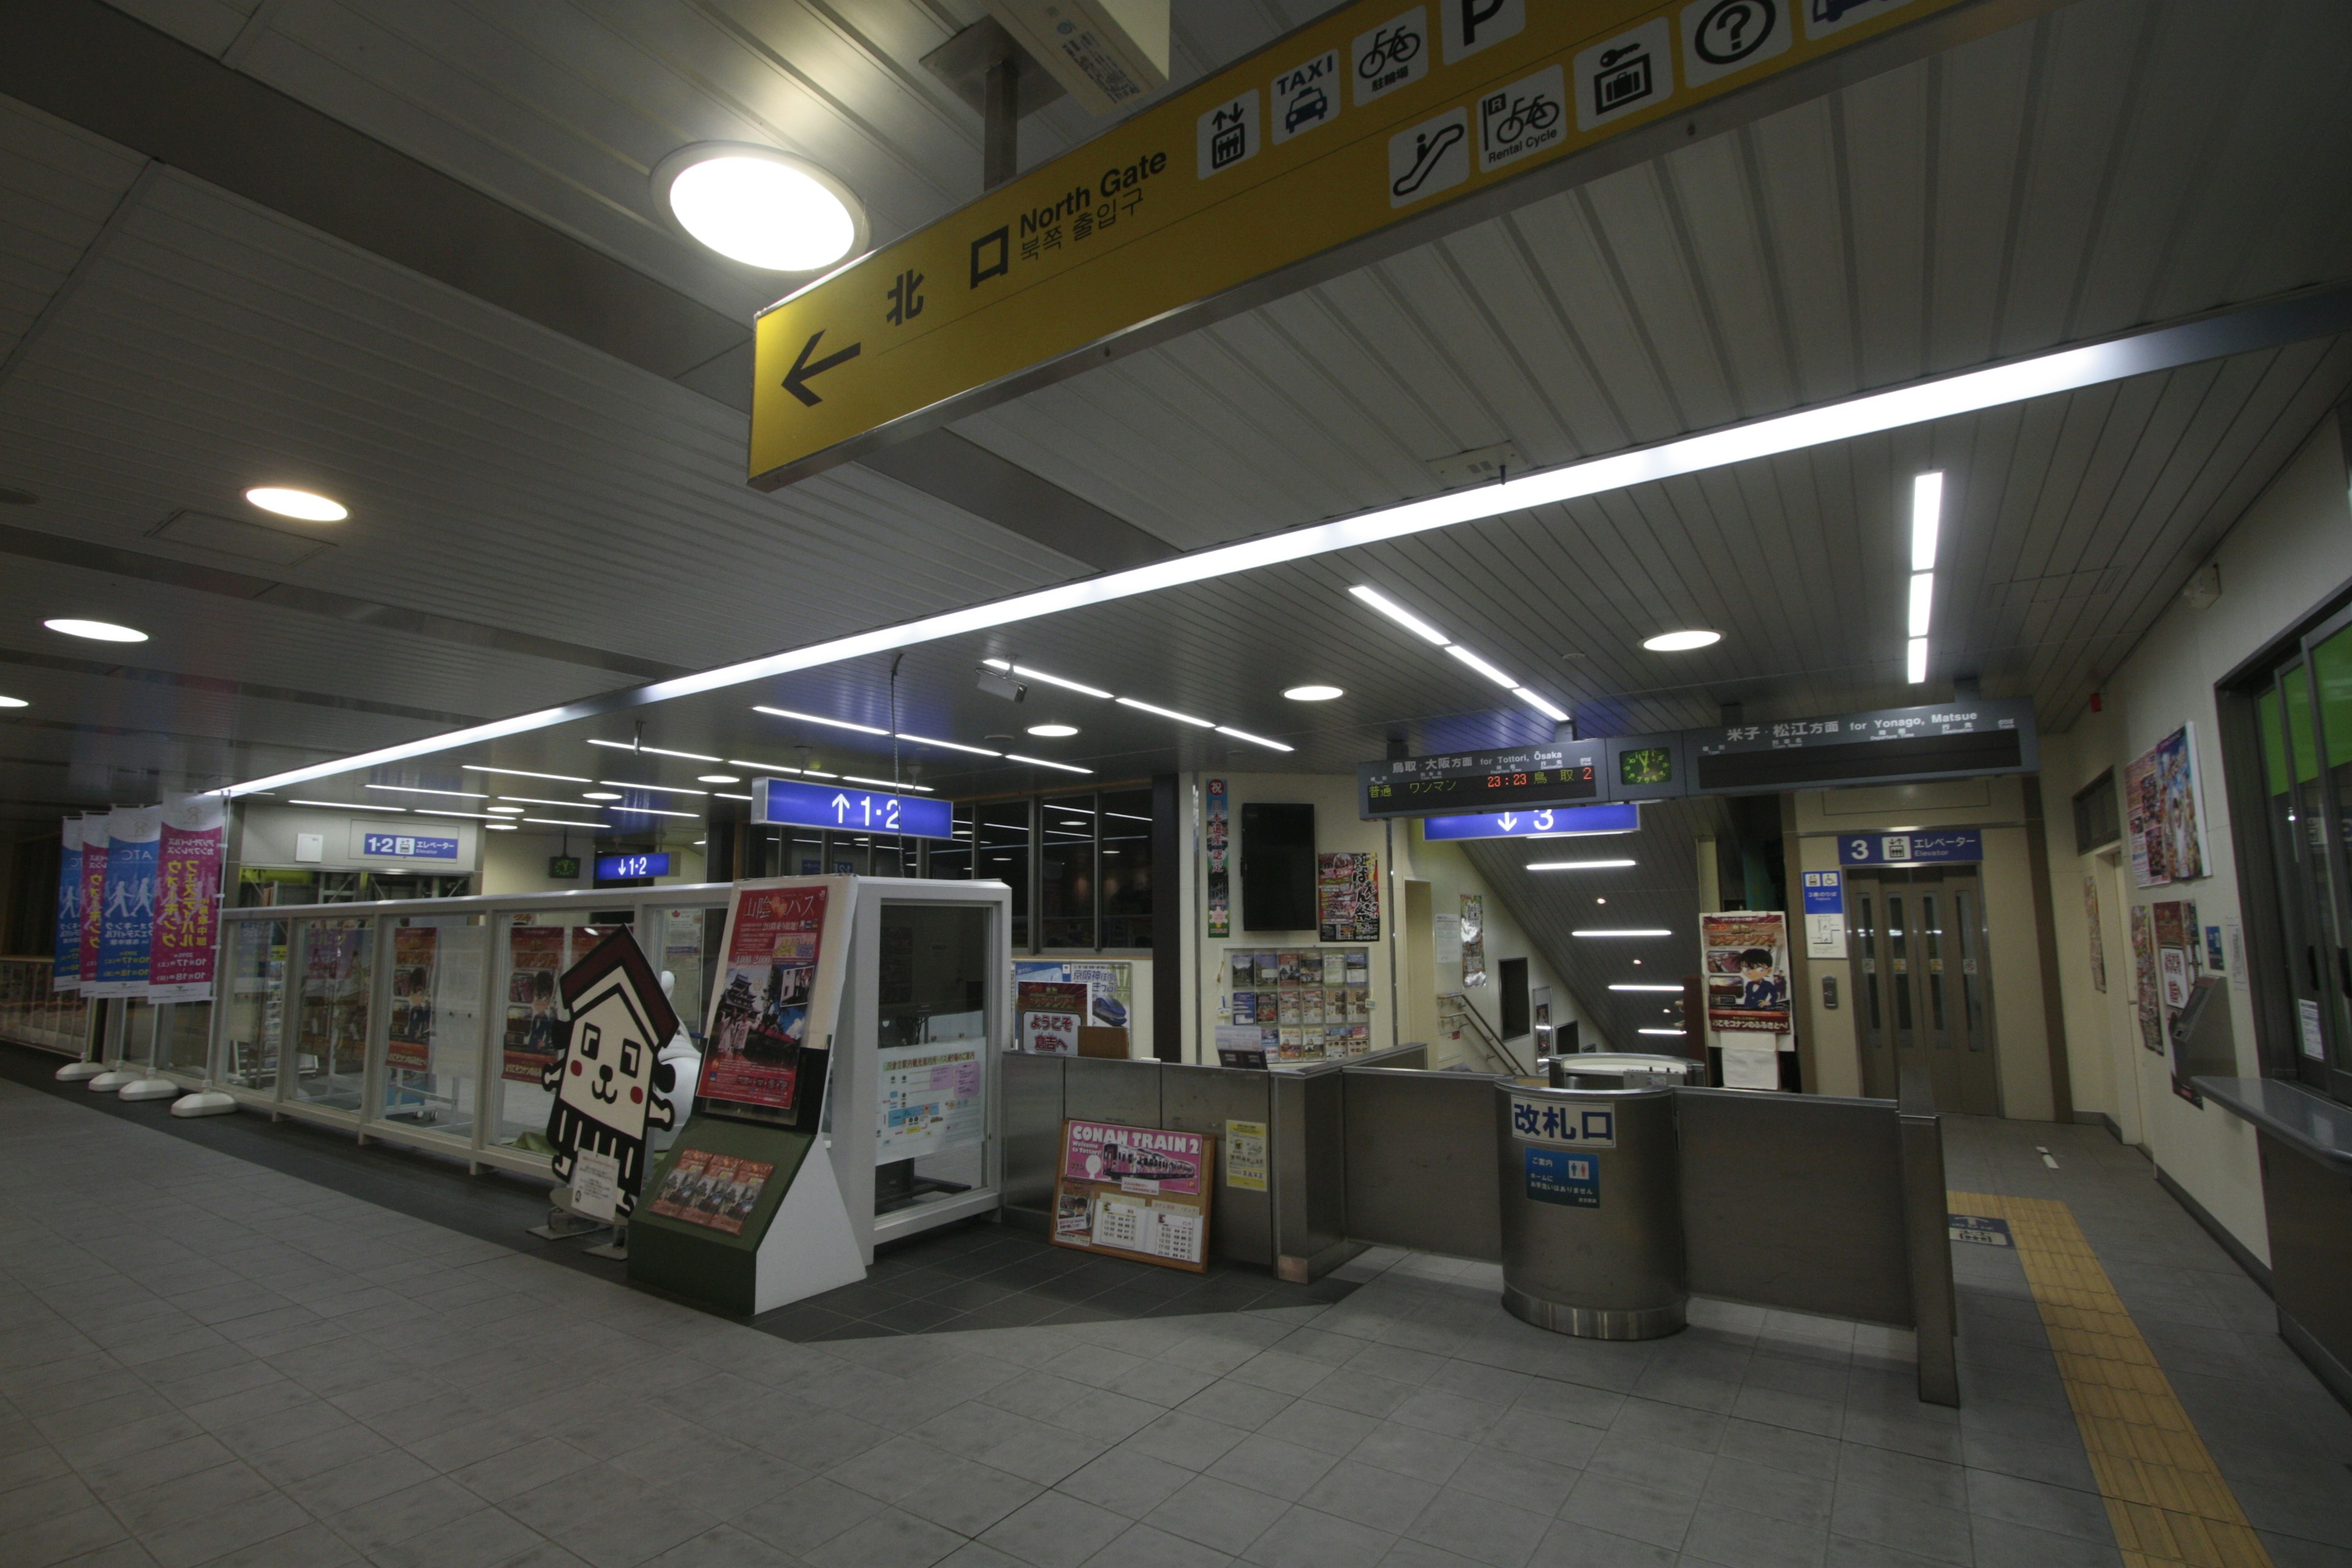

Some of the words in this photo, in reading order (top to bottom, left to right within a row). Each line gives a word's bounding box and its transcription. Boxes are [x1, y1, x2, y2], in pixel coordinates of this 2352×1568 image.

[1276, 55, 1333, 96] TAXI
[1372, 66, 1408, 92] 駐輪場
[1491, 96, 1504, 112] R
[1488, 141, 1523, 164] Rental
[1526, 127, 1558, 153] Cycle
[1020, 187, 1090, 239] North
[1100, 152, 1167, 197] Gate
[1020, 224, 1063, 261] 북쪽
[1072, 187, 1144, 241] 출입구
[1850, 722, 1867, 731] for
[1874, 717, 1925, 729] Yonago,
[1931, 712, 1978, 723] Matsue
[1498, 755, 1529, 764] Tottori,
[1534, 751, 1562, 761] Ōsaka
[1211, 782, 1223, 794] 祝
[1369, 785, 1392, 798] 普通
[1410, 780, 1457, 794] ワンマン
[1487, 774, 1527, 788] 23:23
[1582, 767, 1593, 780] 2
[1534, 809, 1555, 831] 3
[417, 841, 454, 850] エレベーター
[1212, 800, 1224, 873] 日本遺産認定
[1913, 836, 1976, 848] エレベーター
[1851, 840, 1869, 859] 3
[1031, 1014, 1073, 1033] ようこそ
[1035, 1035, 1068, 1052] 倉吉へ
[1514, 1104, 1613, 1140] 改札口
[1072, 1125, 1128, 1146] CONAN
[1132, 1132, 1187, 1154] TRAIN
[1189, 1138, 1200, 1155] 2
[1072, 1140, 1099, 1150] Welcome
[1532, 1157, 1553, 1167] ご案内
[1530, 1173, 1554, 1182] ホームに
[1531, 1181, 1593, 1195] お手洗いはありません
